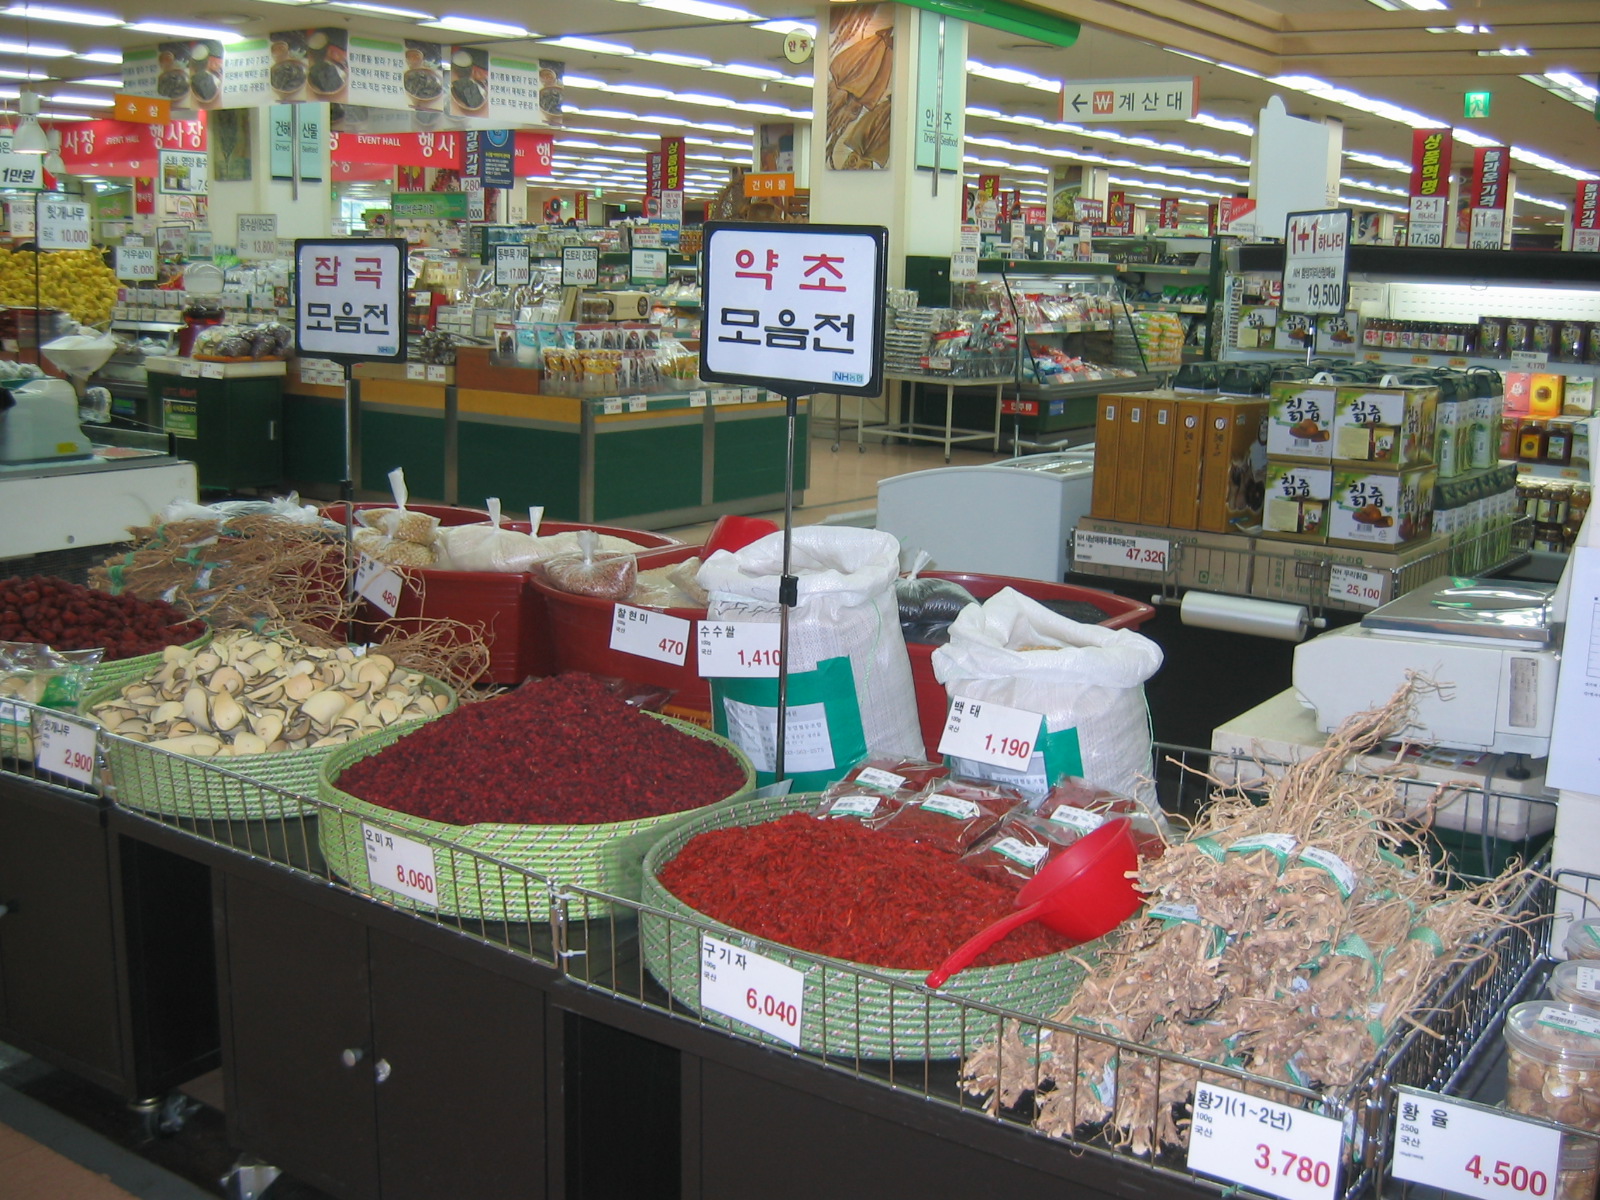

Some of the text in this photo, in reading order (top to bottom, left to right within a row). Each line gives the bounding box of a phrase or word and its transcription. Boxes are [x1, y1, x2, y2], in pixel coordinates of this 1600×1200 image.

[1118, 90, 1184, 112] 계산대
[357, 135, 401, 147] EVENT HALL
[1420, 133, 1442, 195] 상품혁명
[2, 168, 36, 184] 1만원
[751, 178, 787, 192] 건어물
[61, 229, 89, 243] 10,000
[1290, 219, 1344, 255] 1+1 하나더
[1410, 233, 1440, 246] 17,150
[576, 270, 596, 281] 6,400
[1307, 283, 1341, 308] 19,500
[305, 301, 391, 336] 모음전
[717, 306, 855, 356] 모음전
[1285, 395, 1320, 423] 칡즙
[1350, 399, 1381, 424] 칡즙
[1280, 473, 1311, 498] 칡즙
[1348, 480, 1384, 508] 칡즙
[1125, 548, 1166, 565] 47,320
[1346, 584, 1380, 600] 25,100
[617, 607, 649, 625] 찰현미
[699, 625, 736, 640] 수수쌀
[658, 637, 684, 656] 470
[737, 649, 782, 668] 1,410
[984, 733, 1030, 759] 1,190
[64, 748, 93, 773] 2,900
[365, 829, 394, 851] 오미자
[396, 864, 434, 894] 8,060
[703, 941, 748, 971] 구기자
[703, 970, 717, 983] 국산
[746, 987, 798, 1027] 6,040
[1195, 1111, 1213, 1124] 100g
[1197, 1088, 1293, 1132] 황기(1~2년)
[1194, 1124, 1214, 1139] 국산
[1399, 1122, 1420, 1136] 250g
[1399, 1134, 1421, 1149] 국산
[1254, 1142, 1331, 1188] 3,780
[1464, 1154, 1548, 1197] 4,500
